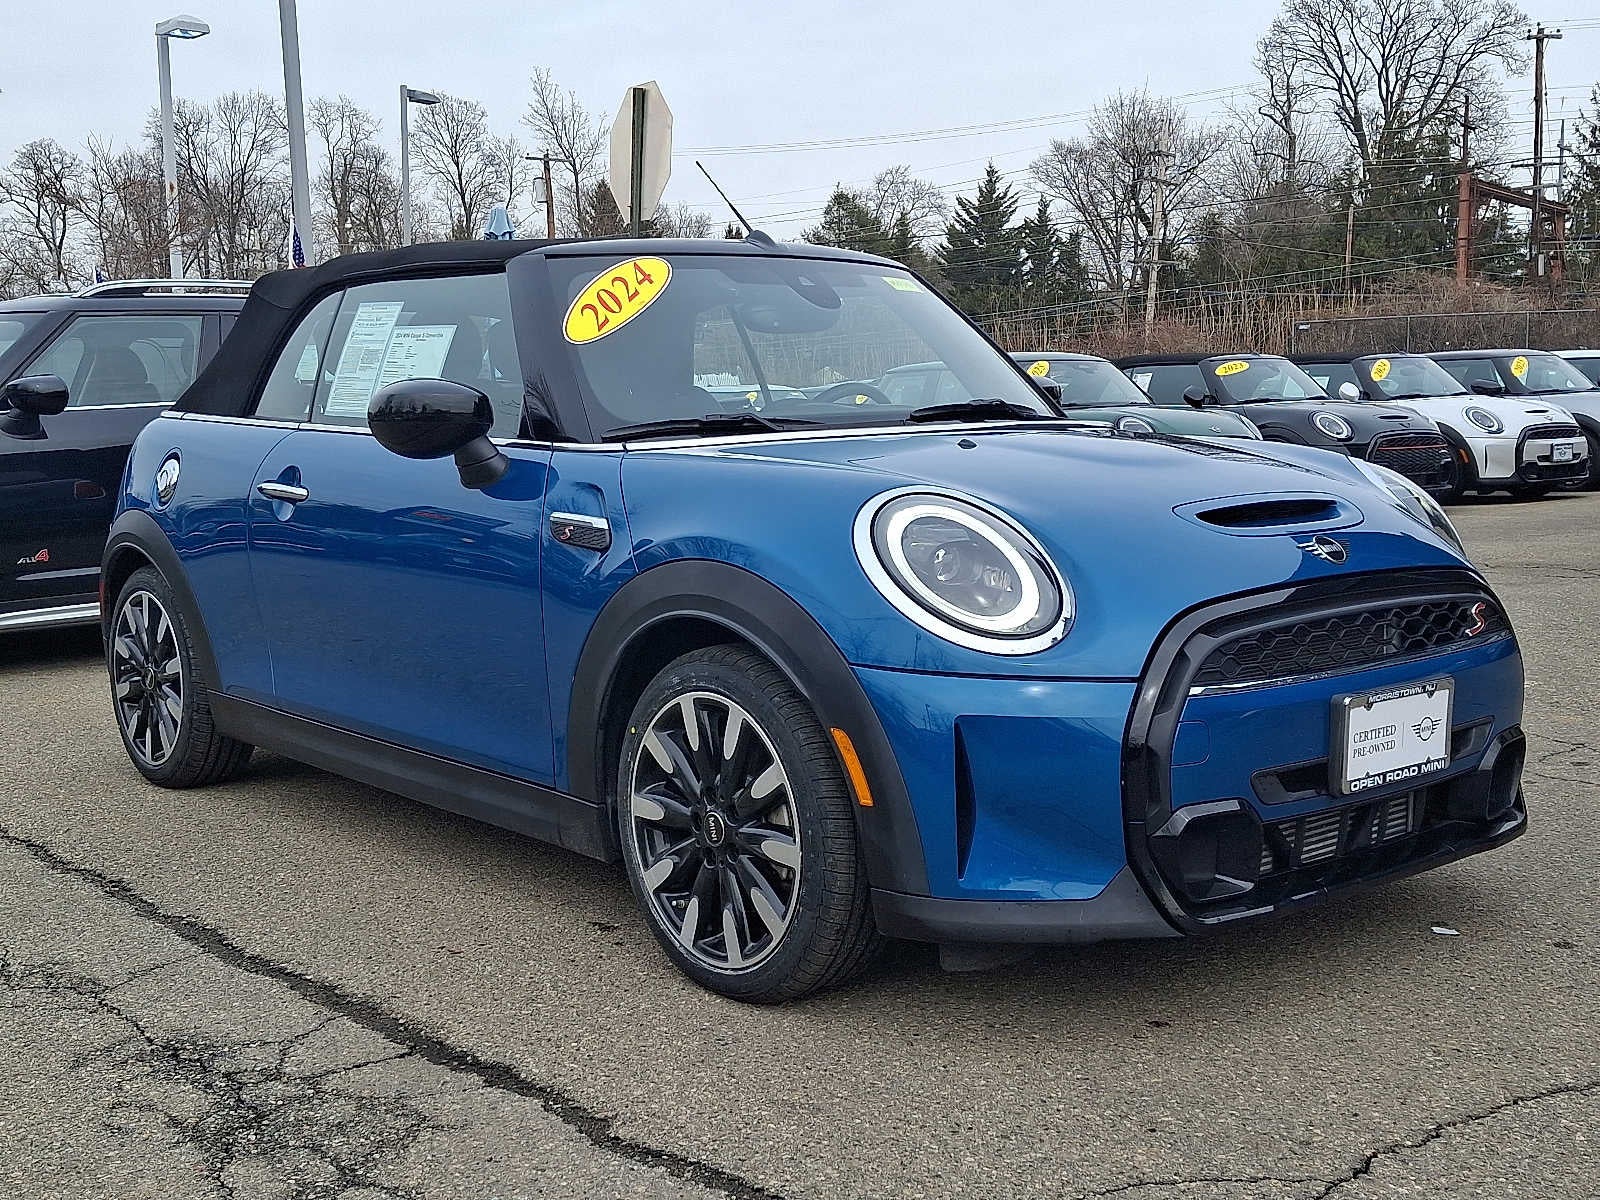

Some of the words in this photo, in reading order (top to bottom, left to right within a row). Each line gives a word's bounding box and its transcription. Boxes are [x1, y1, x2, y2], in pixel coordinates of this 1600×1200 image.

[580, 261, 655, 333] 2024
[560, 525, 574, 540] S
[16, 548, 50, 565] ALL4
[1464, 601, 1487, 637] S
[1425, 683, 1437, 692] NJ
[1353, 724, 1397, 744] CERTIFIED
[1421, 724, 1433, 733] MINI
[1352, 739, 1396, 759] PRE-OWNED
[1350, 775, 1384, 792] OPEN
[1385, 766, 1418, 781] ROAD
[1420, 759, 1446, 774] MINI
[708, 816, 718, 841] MINI
